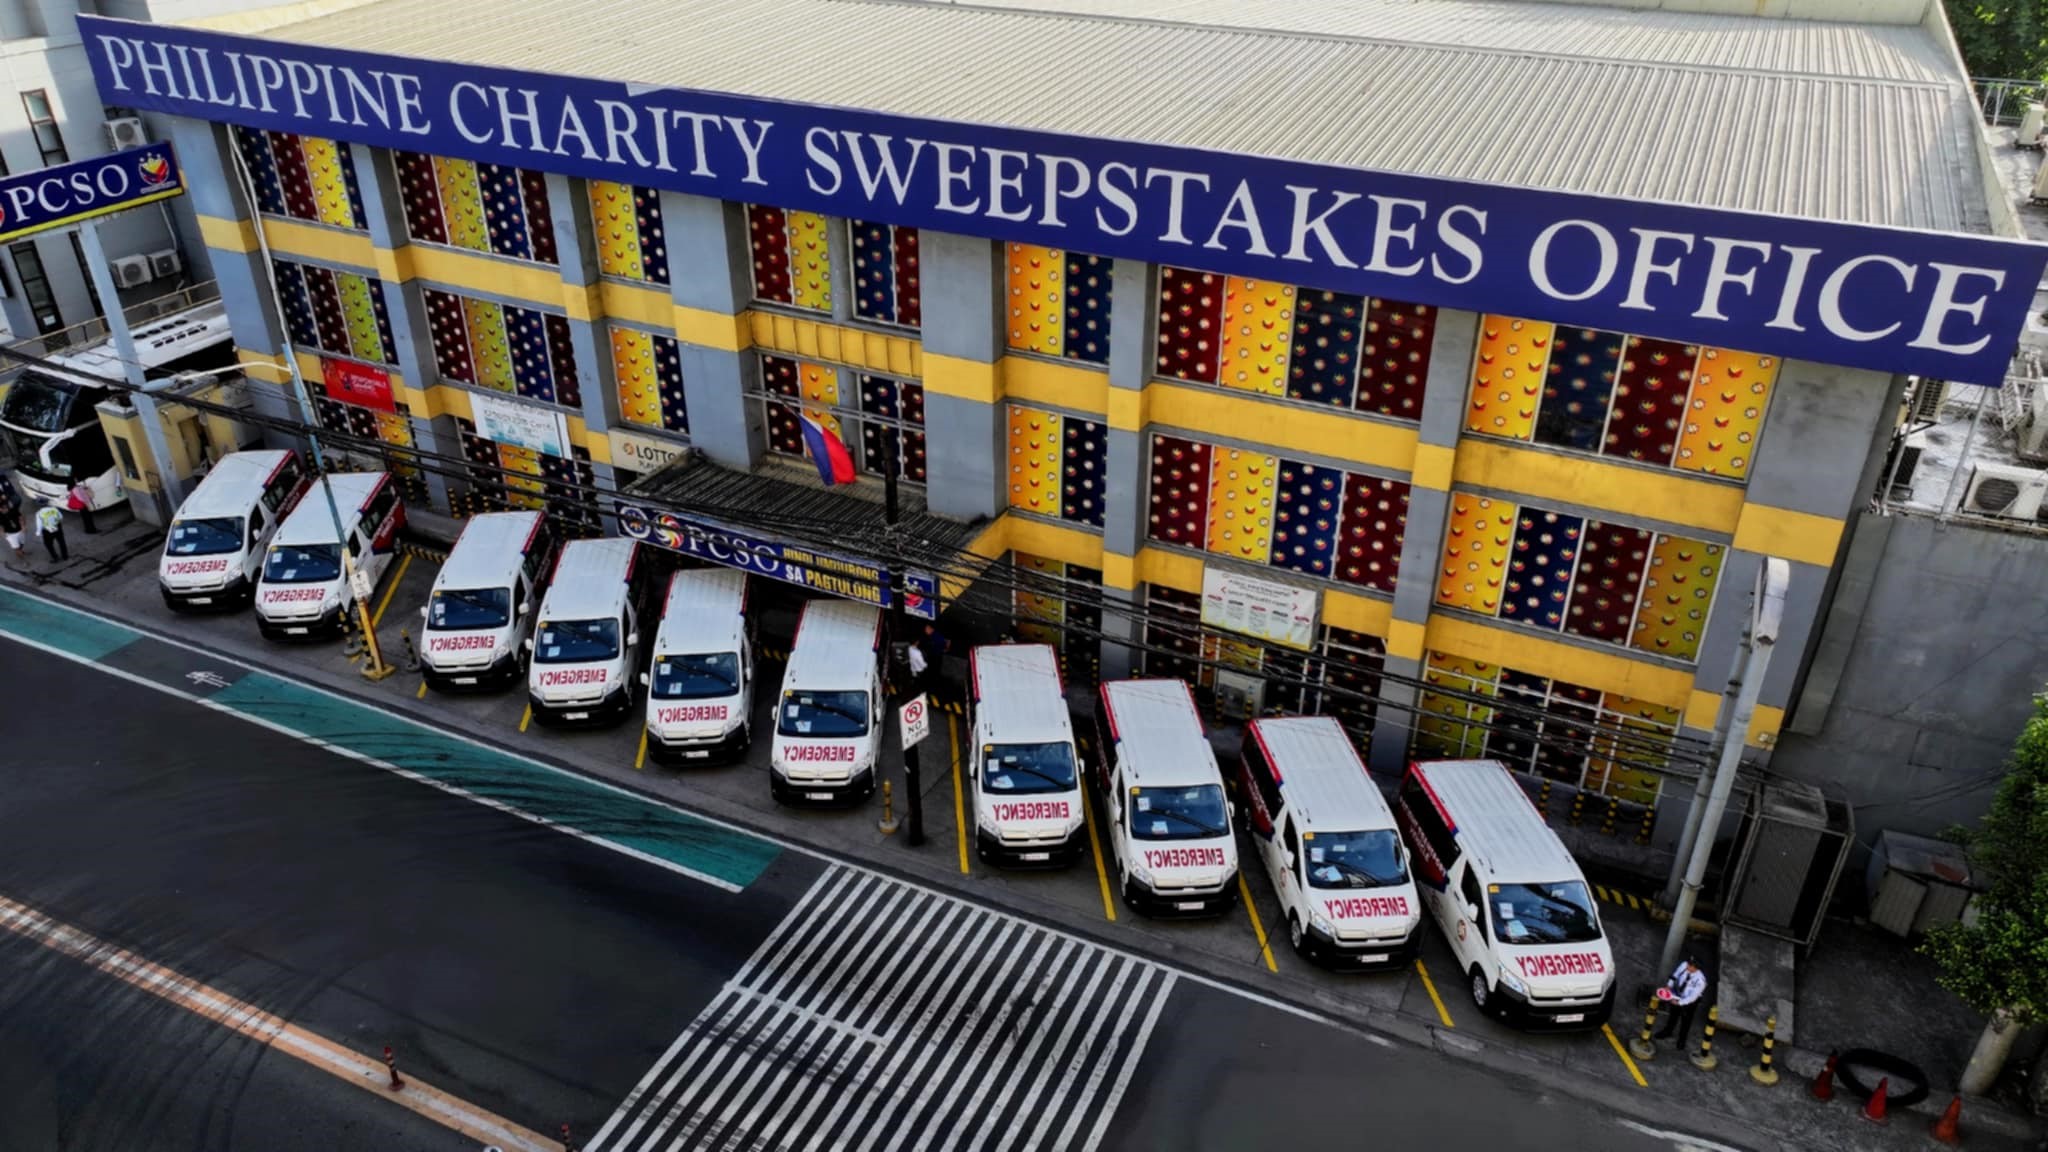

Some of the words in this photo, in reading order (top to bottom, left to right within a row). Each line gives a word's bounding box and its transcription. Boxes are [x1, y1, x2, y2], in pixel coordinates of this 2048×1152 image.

[3, 164, 129, 222] PCSO
[97, 35, 431, 135] PHILIPPINE
[450, 81, 774, 186] CHARITY
[805, 127, 1488, 284] SWEEPSTAKES
[1528, 219, 2006, 355] OFFICE
[685, 524, 779, 572] PCSO
[785, 564, 804, 583] SA
[805, 569, 880, 602] PAGTULONG
